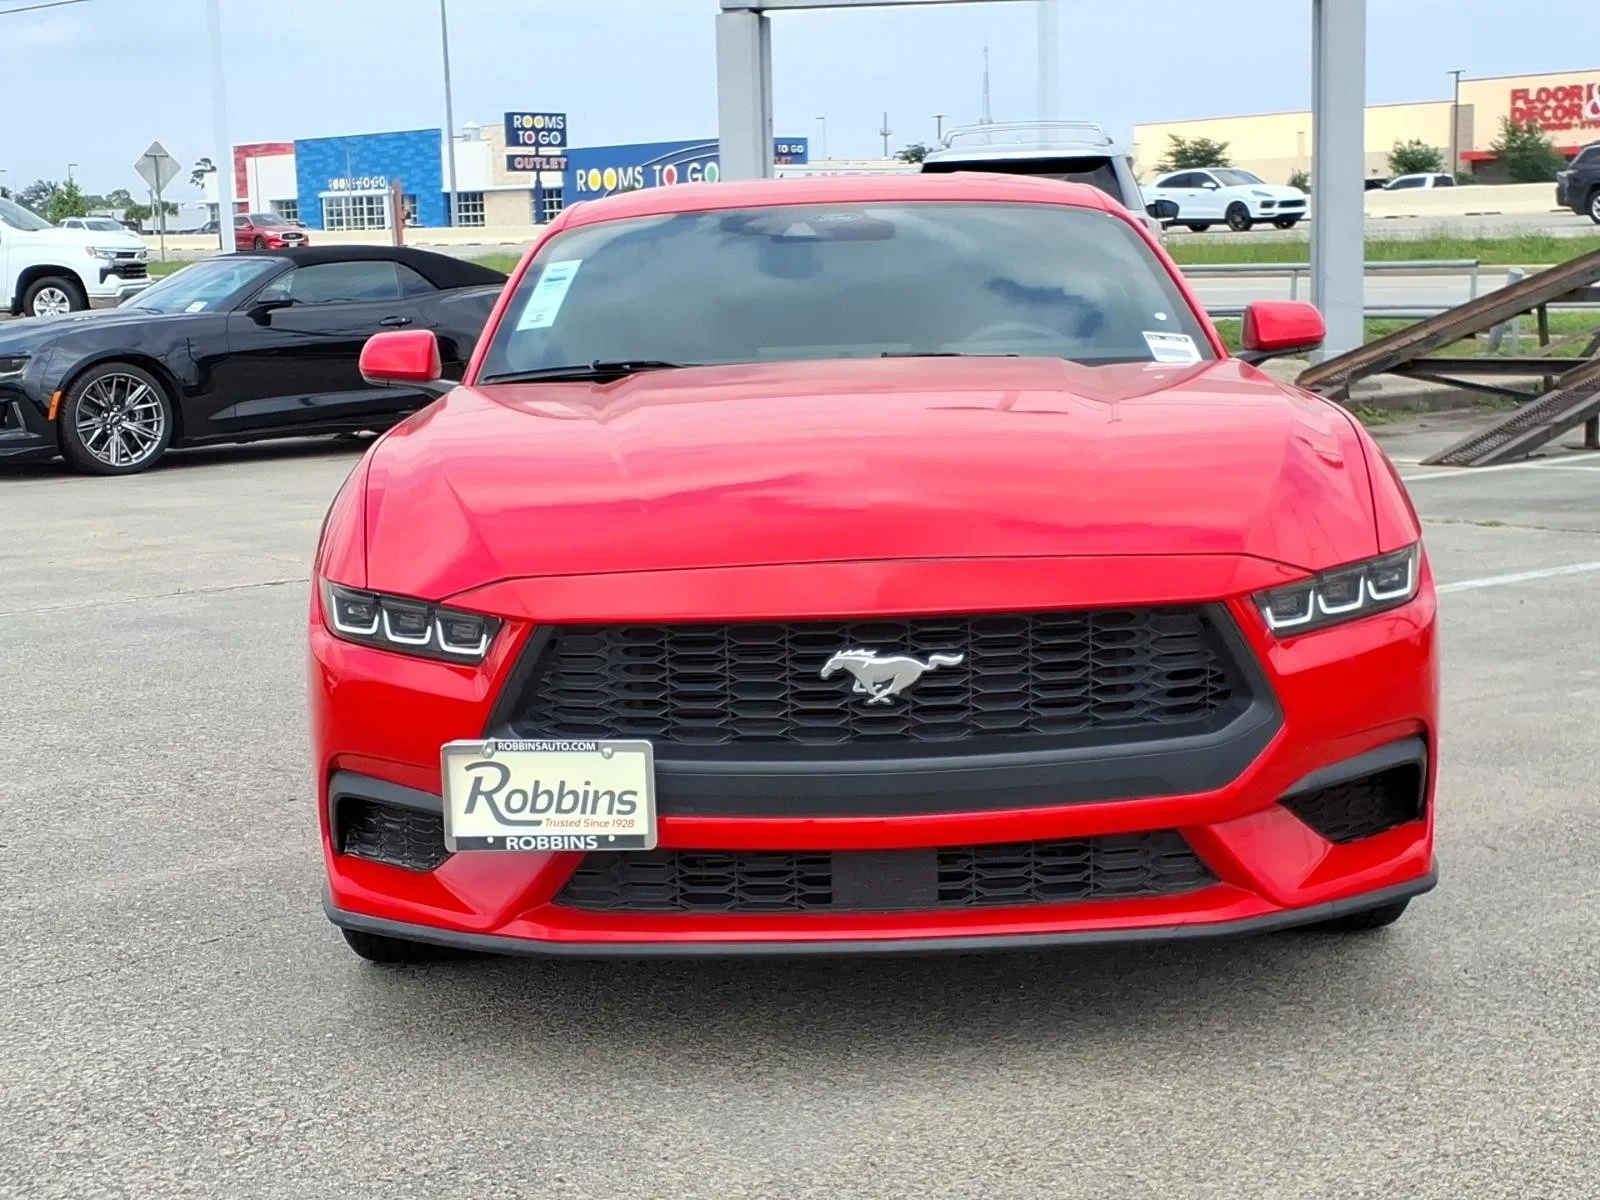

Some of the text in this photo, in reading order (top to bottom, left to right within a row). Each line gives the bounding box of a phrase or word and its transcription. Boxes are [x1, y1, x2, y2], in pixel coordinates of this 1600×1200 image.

[1511, 85, 1583, 106] FLOOR
[1511, 103, 1583, 124] DECOR
[513, 115, 564, 129] ROOMS
[517, 130, 561, 144] TO GO
[777, 144, 804, 153] TO GO
[514, 157, 567, 169] OUTLET
[576, 161, 719, 192] ROOMS TO GO
[497, 741, 596, 751] ROBBINSAUTO.COM
[464, 760, 638, 826] Robbins
[545, 818, 635, 828] Trusted Since 1928
[505, 835, 598, 850] ROBBINS
